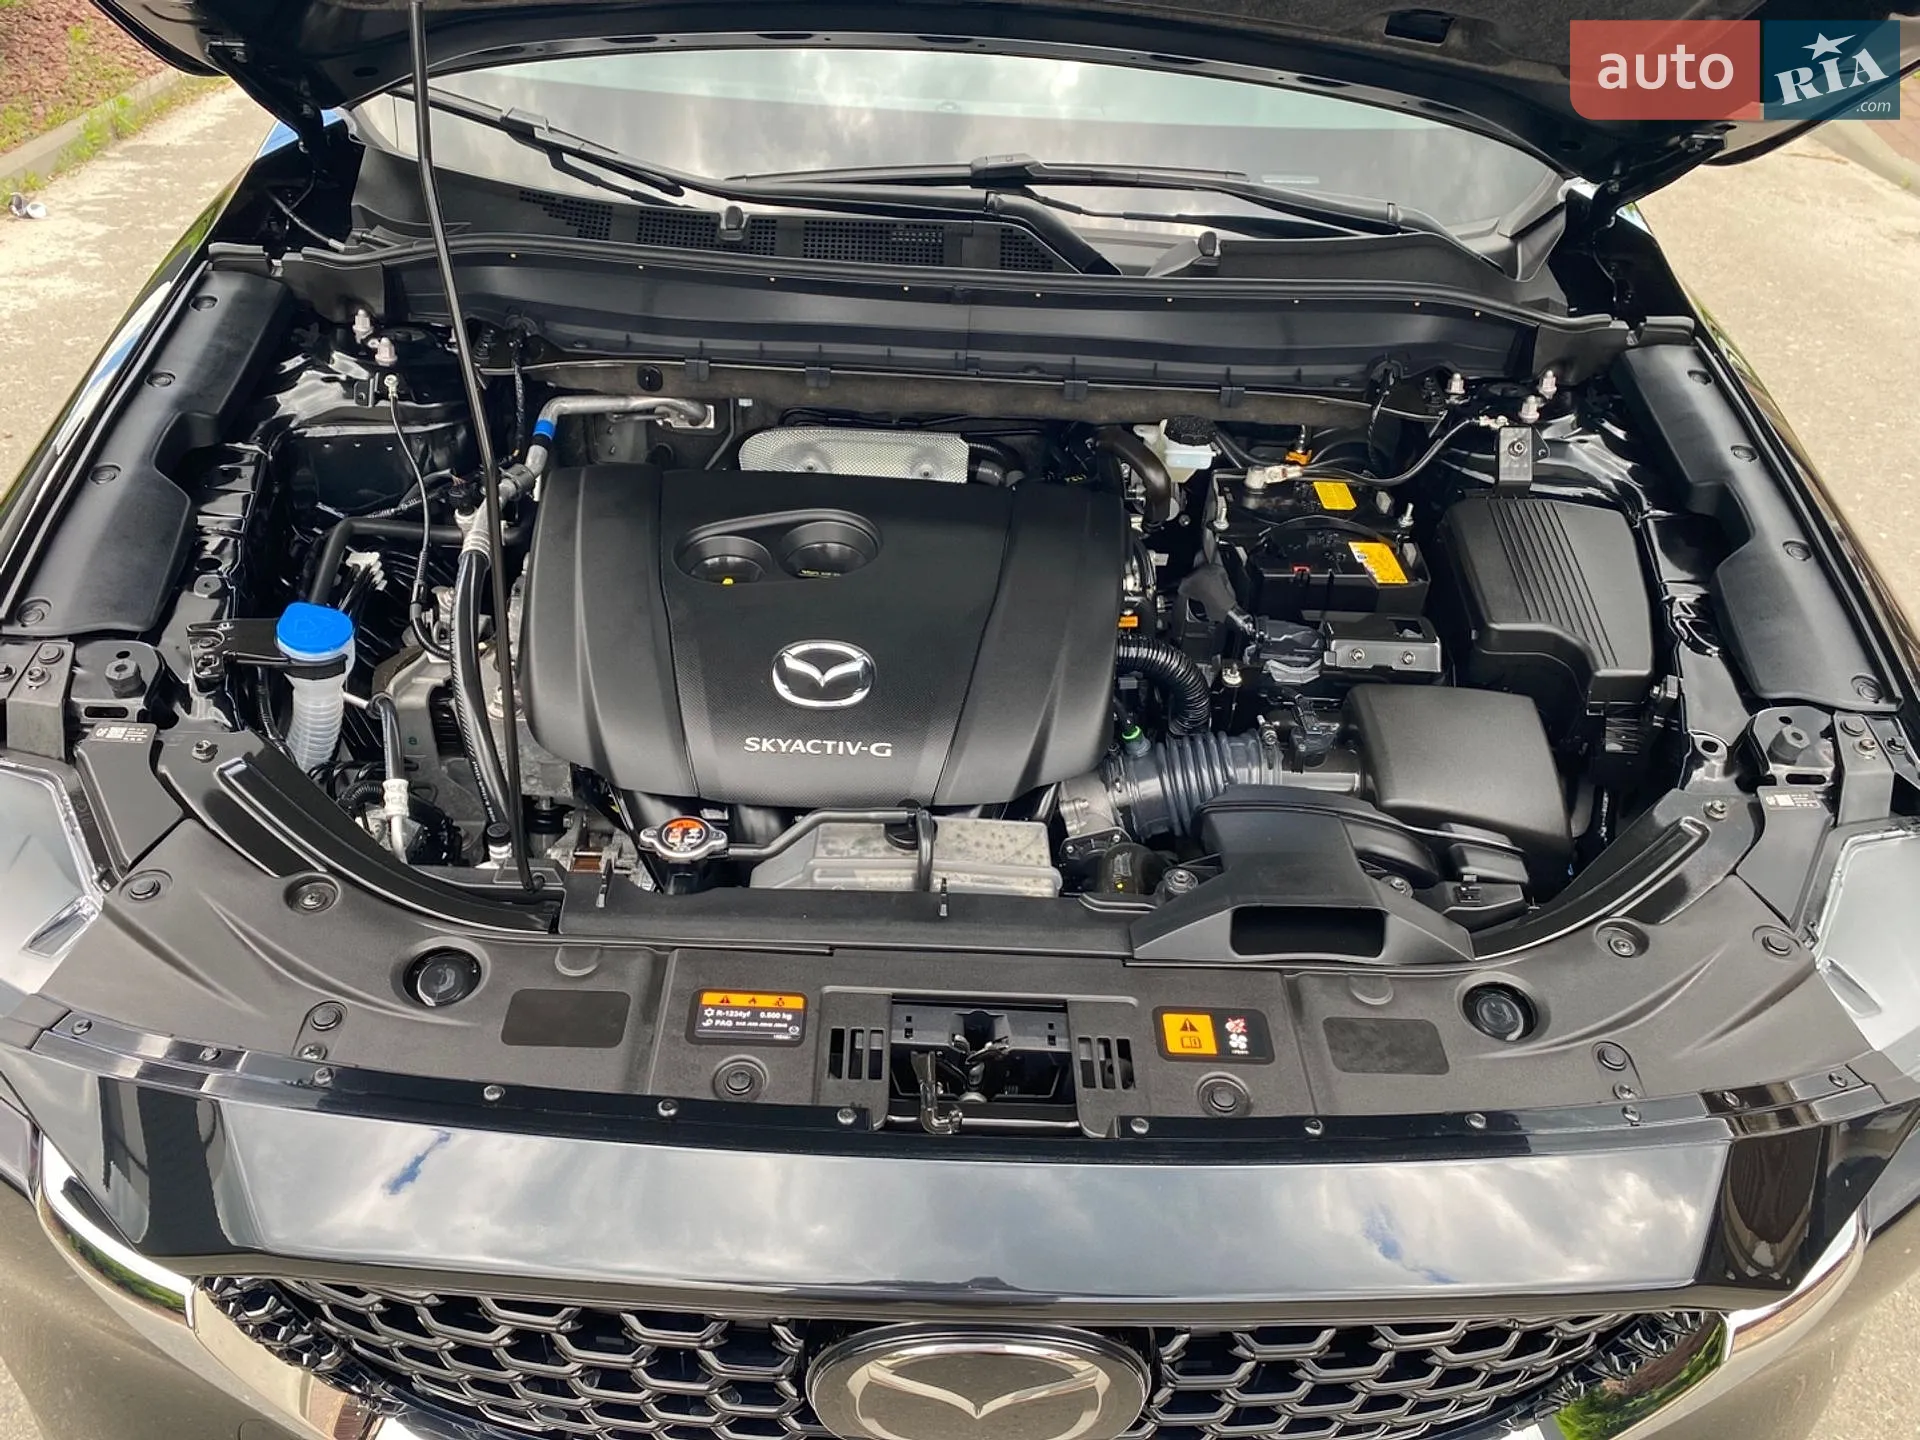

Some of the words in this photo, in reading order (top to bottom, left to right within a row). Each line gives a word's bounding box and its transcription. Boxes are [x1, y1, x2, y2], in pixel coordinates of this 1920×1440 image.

[744, 736, 893, 757] SKYACTIV-G
[782, 1012, 793, 1021] kg
[714, 1019, 734, 1027] PAG
